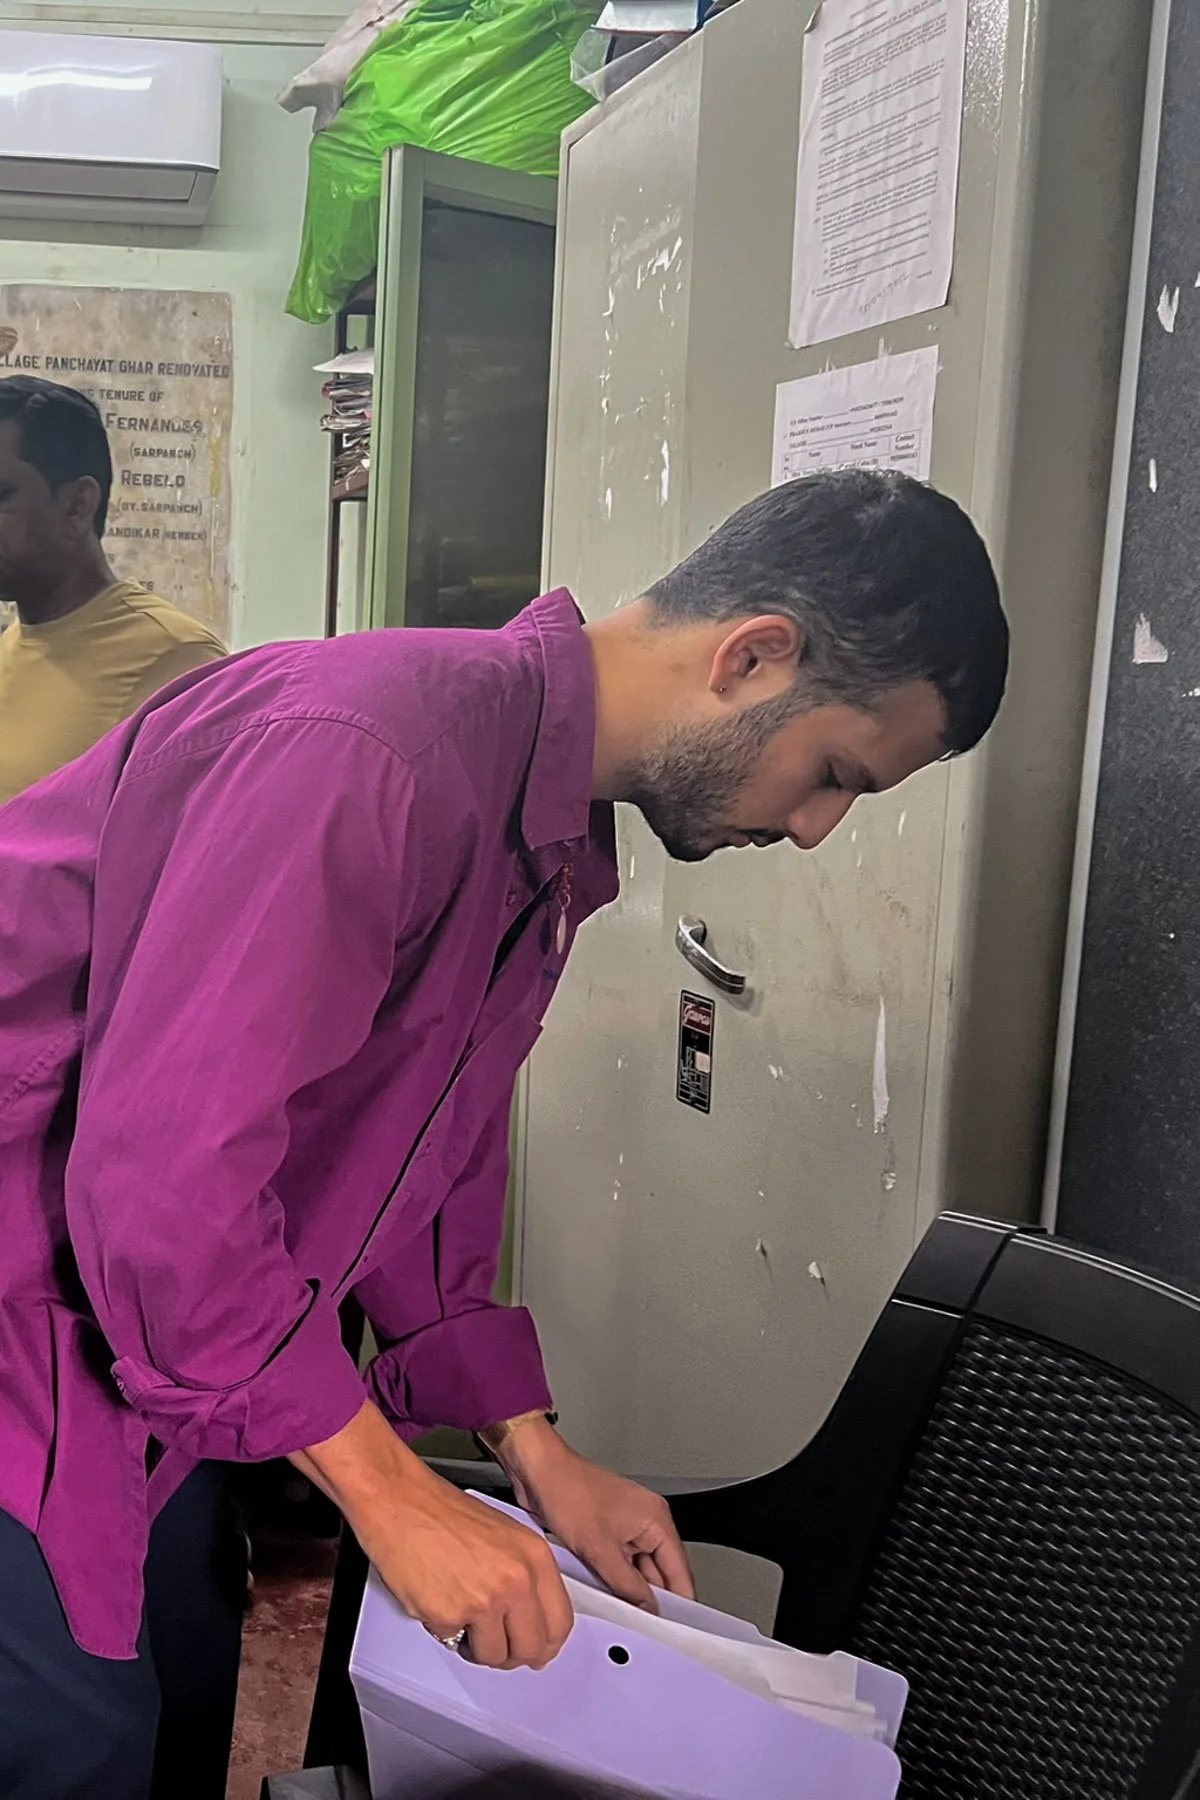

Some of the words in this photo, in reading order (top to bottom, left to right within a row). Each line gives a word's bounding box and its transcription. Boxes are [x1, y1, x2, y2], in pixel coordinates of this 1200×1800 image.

[45, 356, 114, 372] PANCHAYAT
[119, 360, 153, 375] GHAR
[158, 362, 230, 378] RENOVATED
[100, 388, 145, 402] TENURE
[149, 391, 164, 402] OF
[130, 441, 196, 463] (SARPANCH)
[121, 469, 186, 488] REBELO
